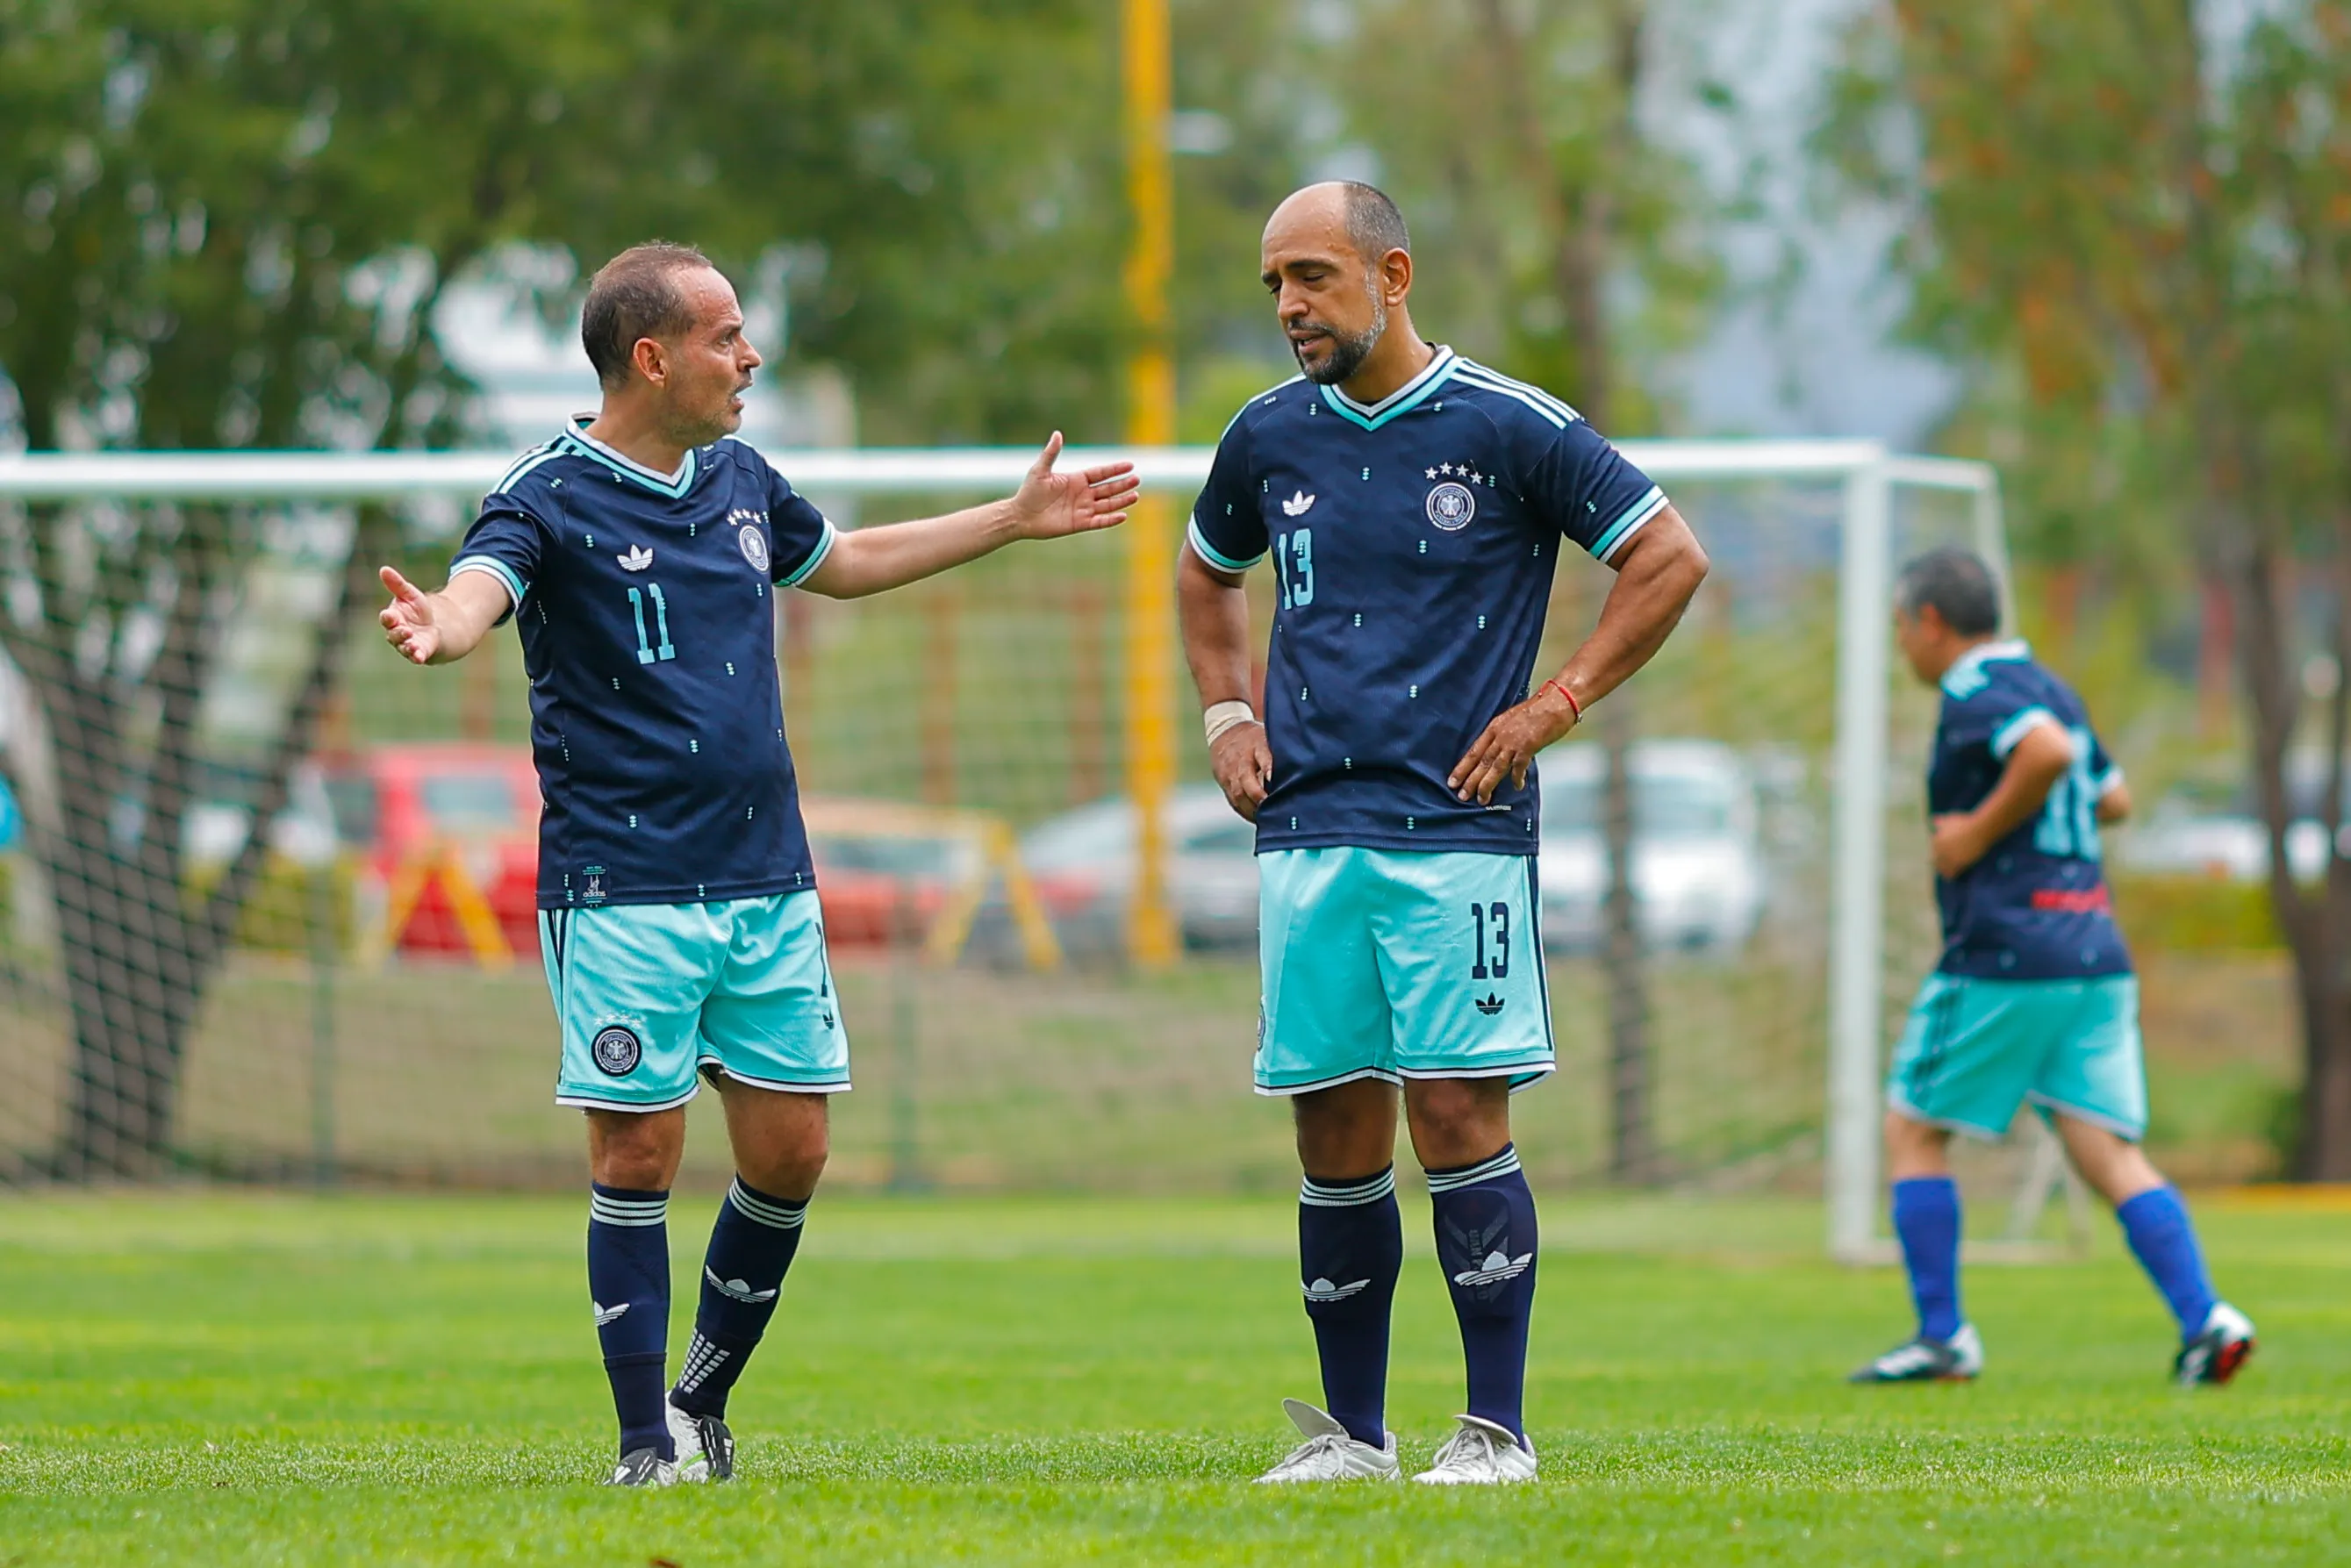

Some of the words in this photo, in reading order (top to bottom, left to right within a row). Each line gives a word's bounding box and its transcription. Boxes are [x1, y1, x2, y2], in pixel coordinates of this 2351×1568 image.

[1278, 528, 1314, 611] 13
[627, 583, 676, 664] 11
[1471, 902, 1509, 979] 13
